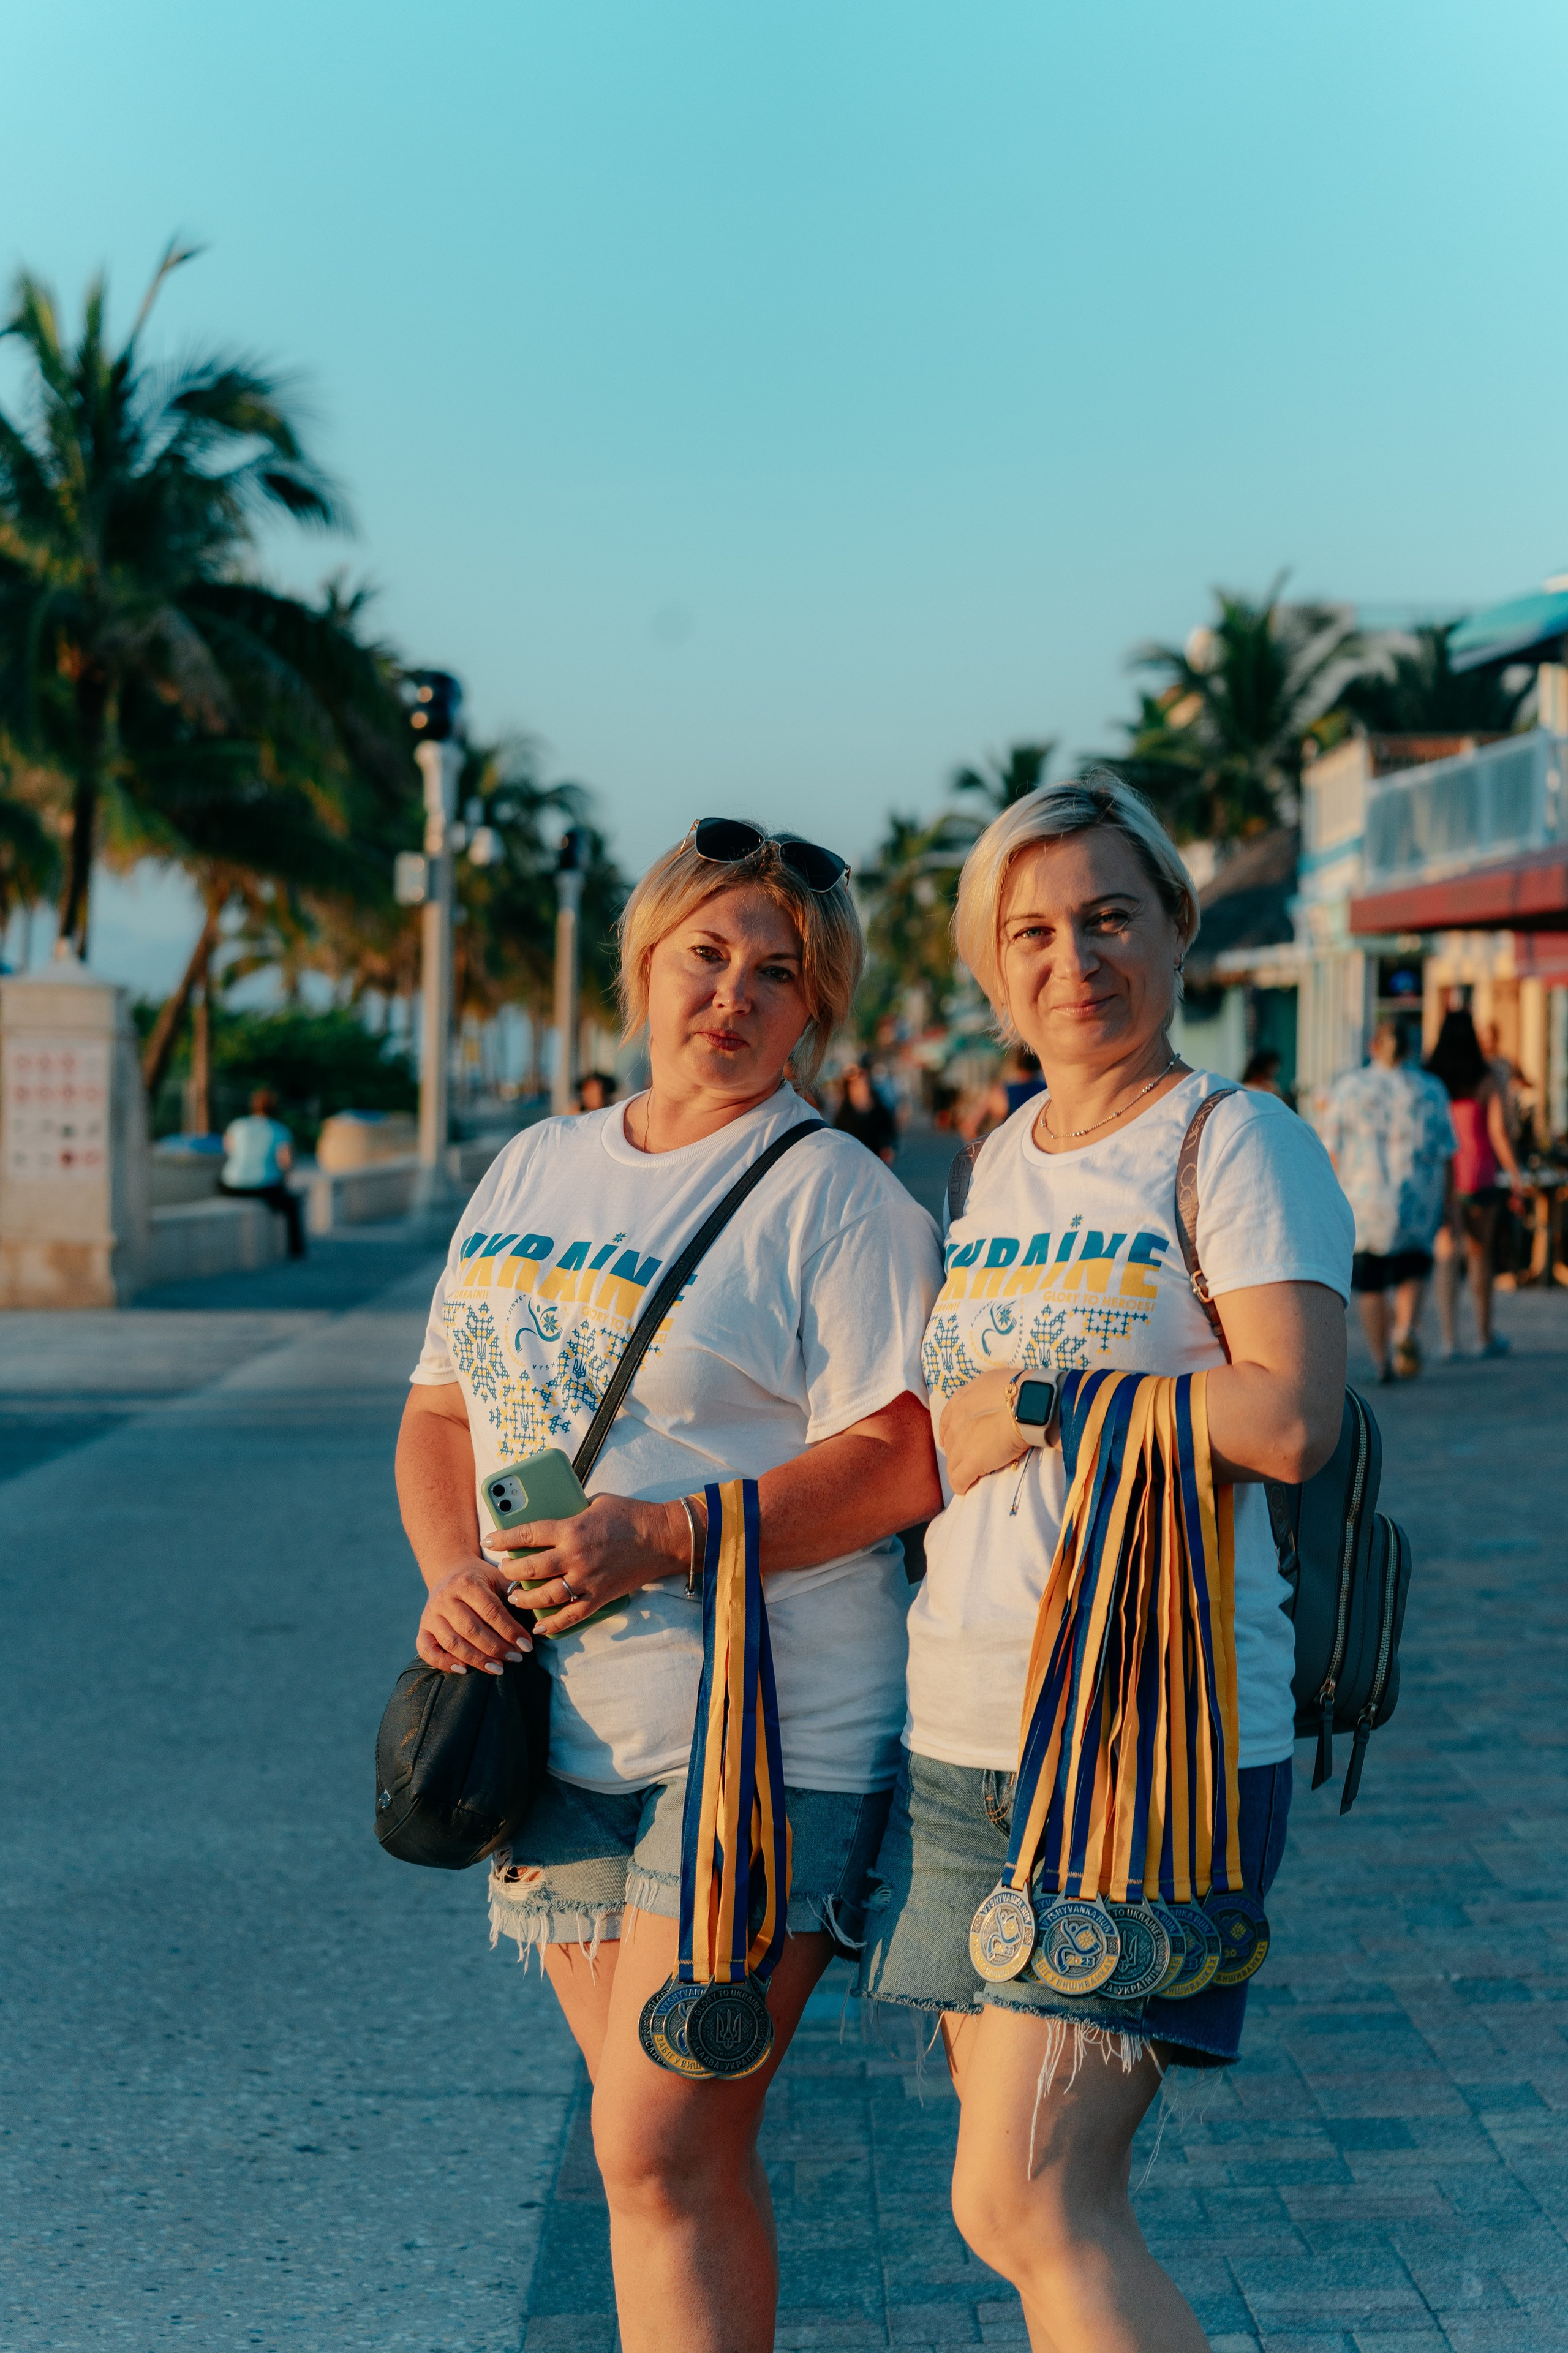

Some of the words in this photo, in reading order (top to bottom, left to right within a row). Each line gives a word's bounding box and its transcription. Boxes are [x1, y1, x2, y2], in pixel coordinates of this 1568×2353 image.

[1043, 1290, 1080, 1304] GLORY
[1083, 1294, 1098, 1306] TO
[1103, 1296, 1155, 1312] HEROES!
[610, 1317, 624, 1331] TO
[981, 1893, 1023, 1914] VYSHYVANKA
[1041, 1905, 1096, 1927] VYSHYVANKA
[1097, 1914, 1112, 1933] RUN
[1113, 1909, 1125, 1917] TO
[1127, 1908, 1163, 1939] UKRAINE!
[1066, 1955, 1094, 1966] 2023
[1056, 1956, 1115, 1990] ВИШИВАНКАХ
[1167, 1957, 1217, 1995] ИШИВАНКАХ
[647, 1989, 669, 2011] GLOR
[660, 1989, 705, 2012] VYSHYVAN
[695, 1993, 716, 2016] GLORY
[731, 1990, 764, 2016] UKRAINE!
[656, 2036, 676, 2059] ЗАБІГ
[695, 2046, 720, 2069] СЛАВА
